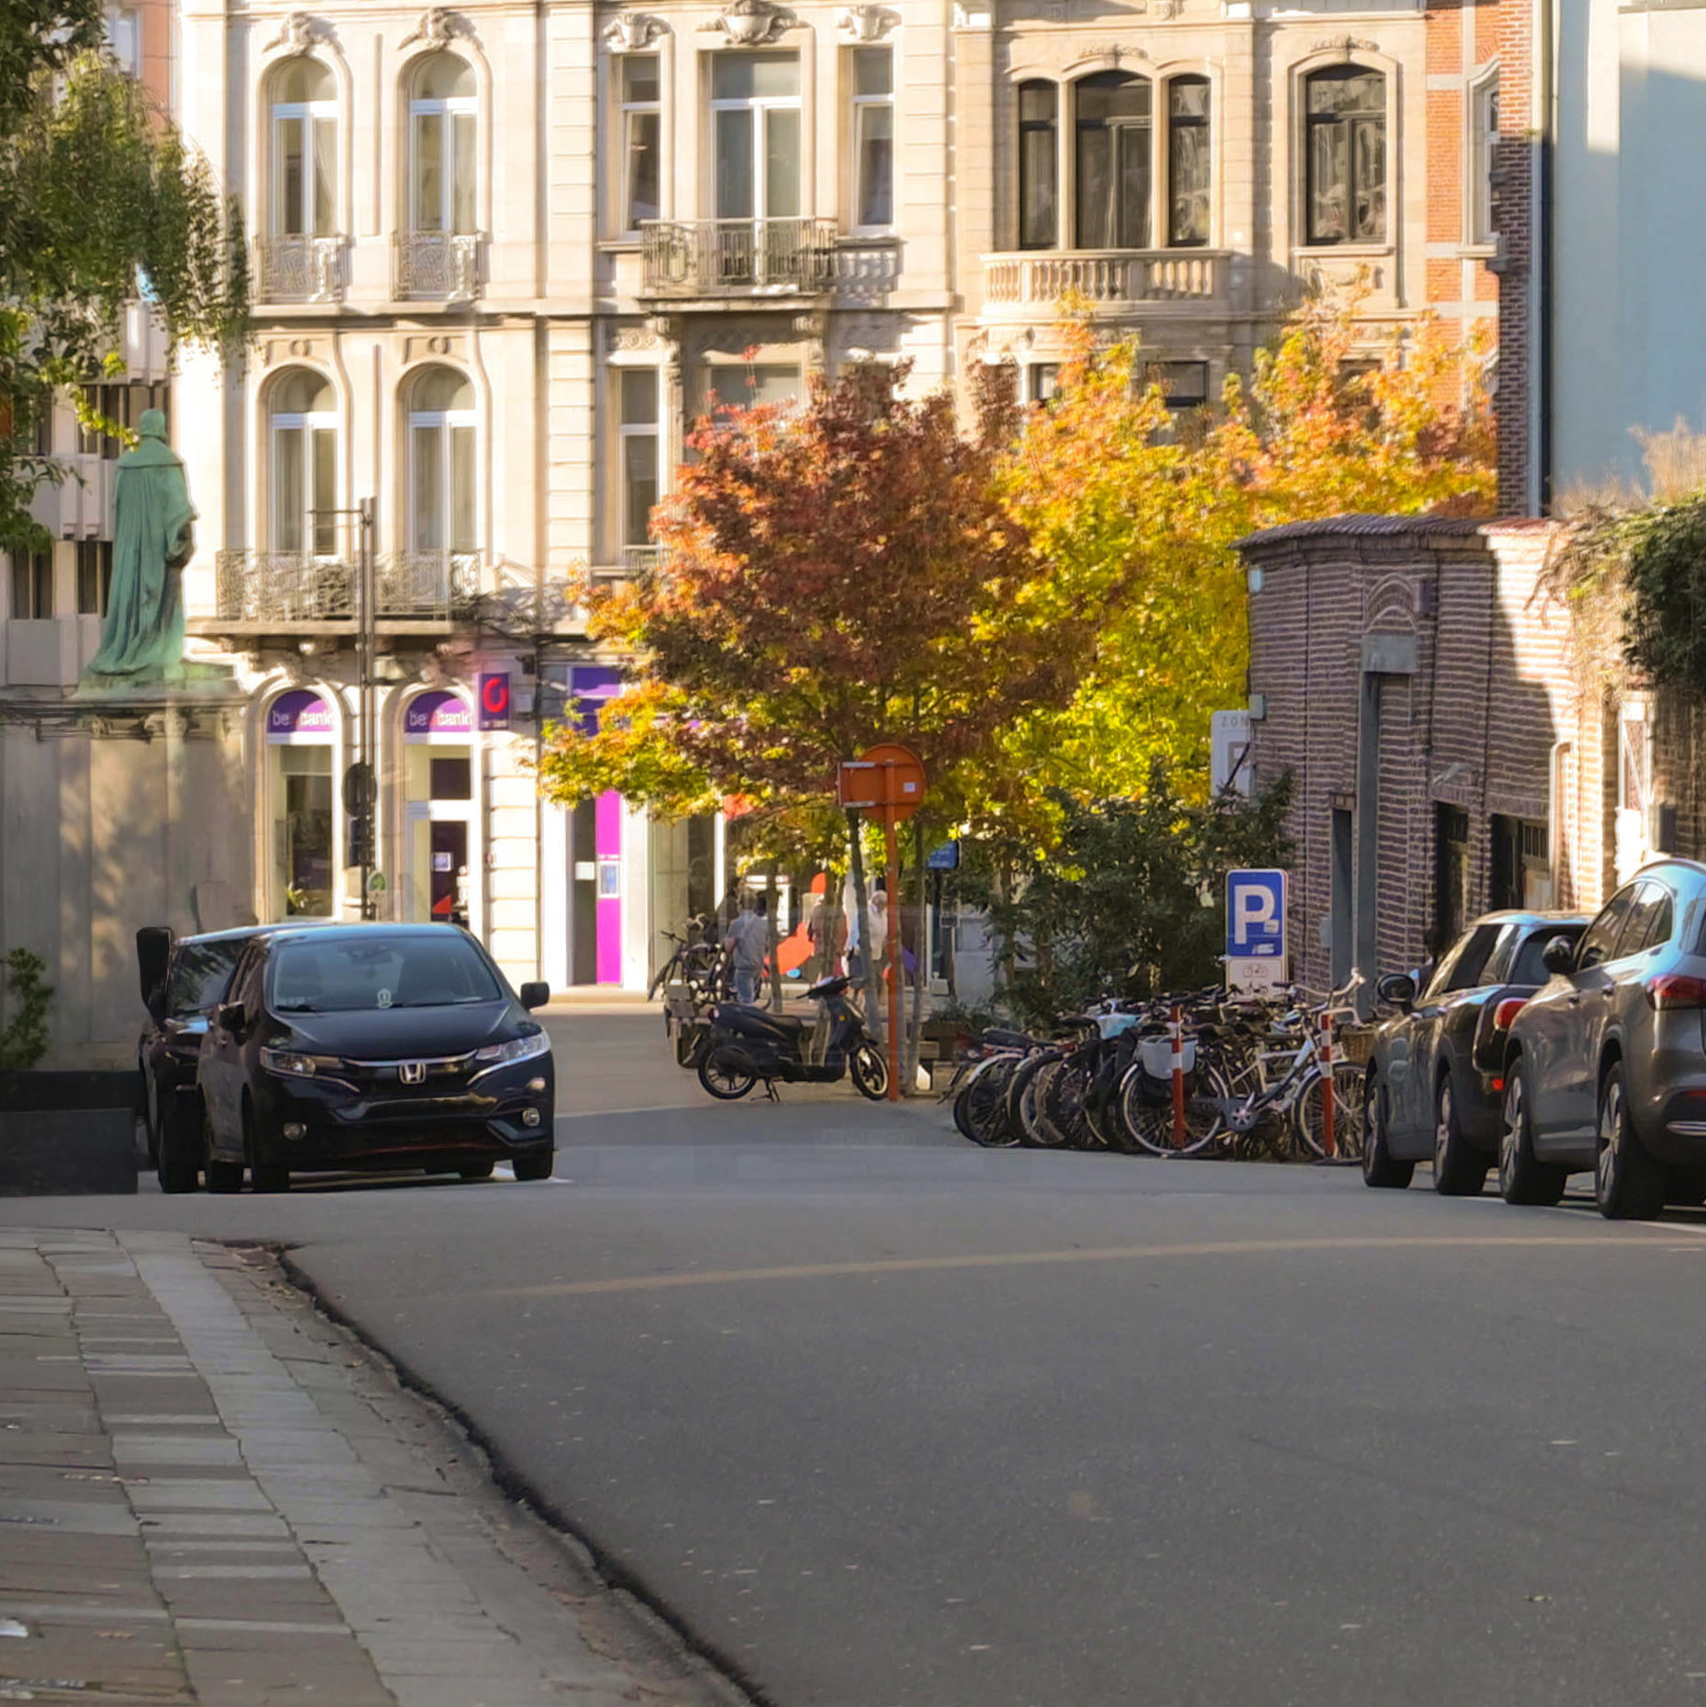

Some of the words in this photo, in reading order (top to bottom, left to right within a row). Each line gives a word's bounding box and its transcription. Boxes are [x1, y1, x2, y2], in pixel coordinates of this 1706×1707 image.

[272, 710, 289, 726] be
[409, 710, 427, 726] be
[1221, 716, 1250, 728] ZON
[1234, 884, 1275, 944] P
